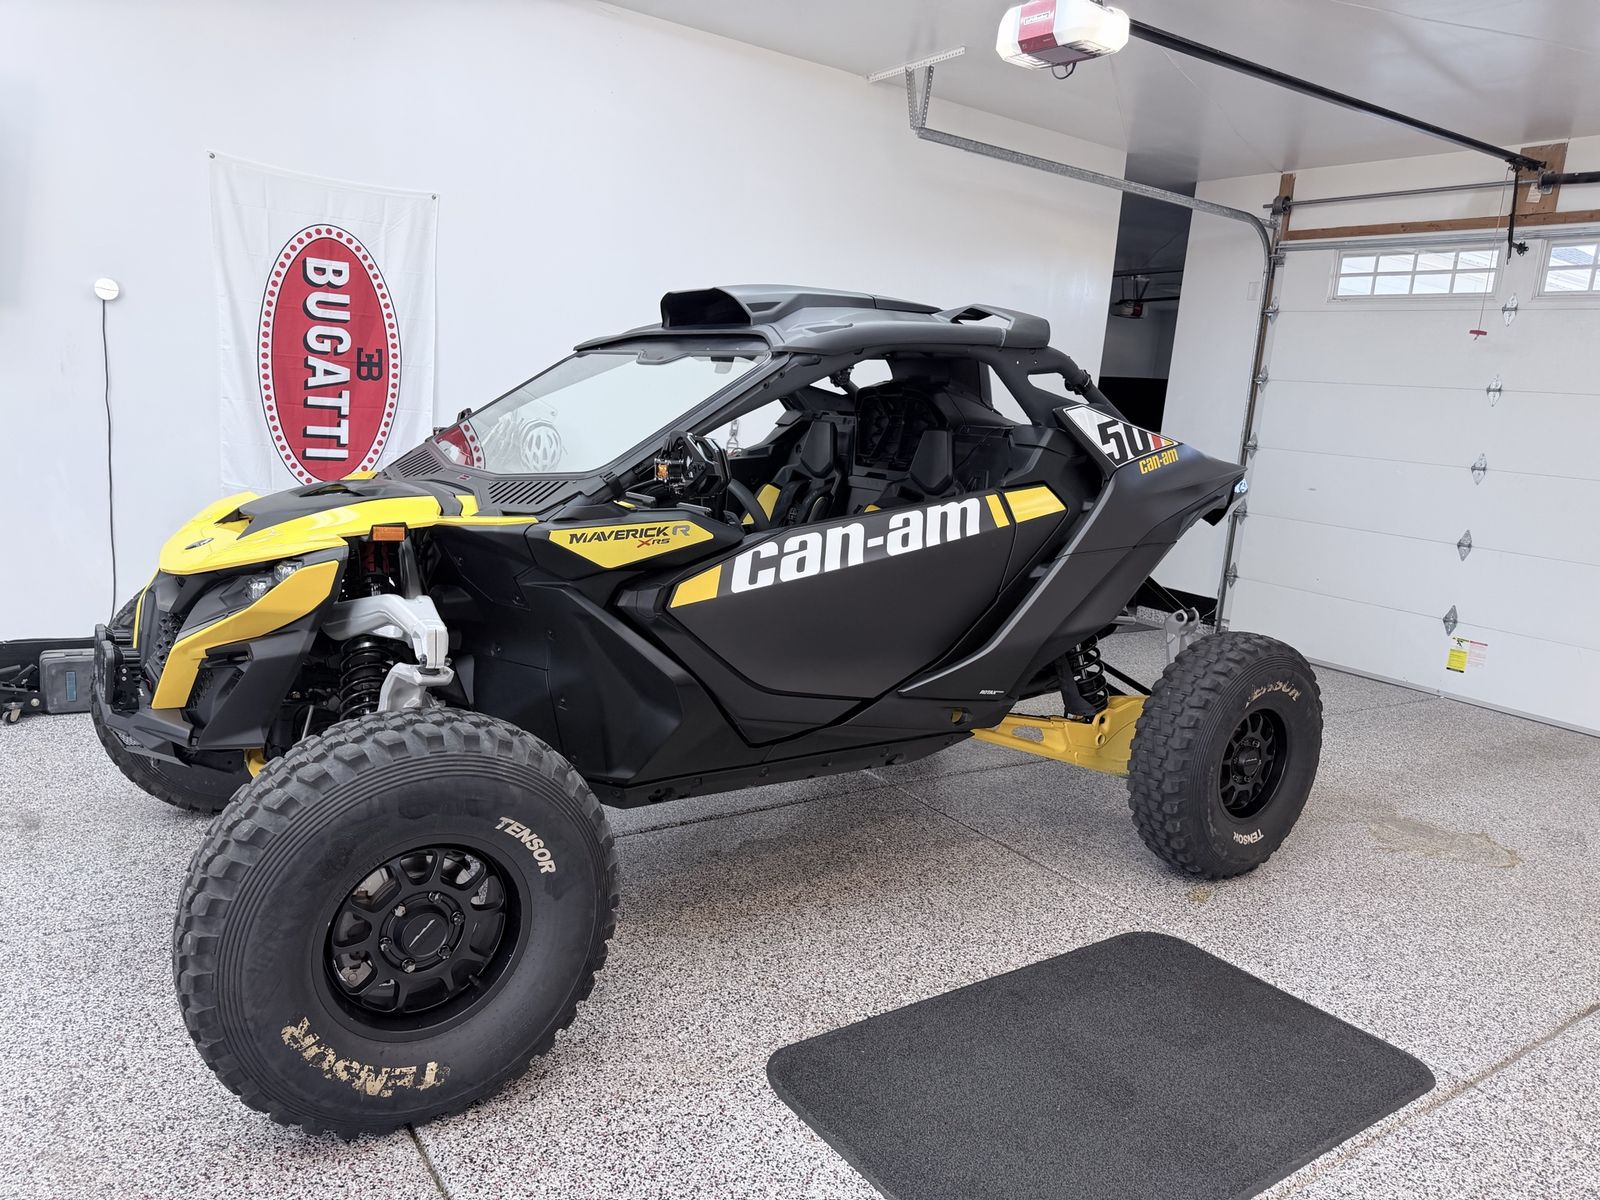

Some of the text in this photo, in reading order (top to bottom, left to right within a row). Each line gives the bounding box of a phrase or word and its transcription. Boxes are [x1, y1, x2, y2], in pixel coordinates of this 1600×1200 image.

[302, 256, 351, 461] BUGATTI
[1138, 448, 1179, 475] can-am
[569, 525, 691, 545] MAVERICK R
[731, 497, 981, 594] can-am
[495, 816, 556, 874] TENSOR
